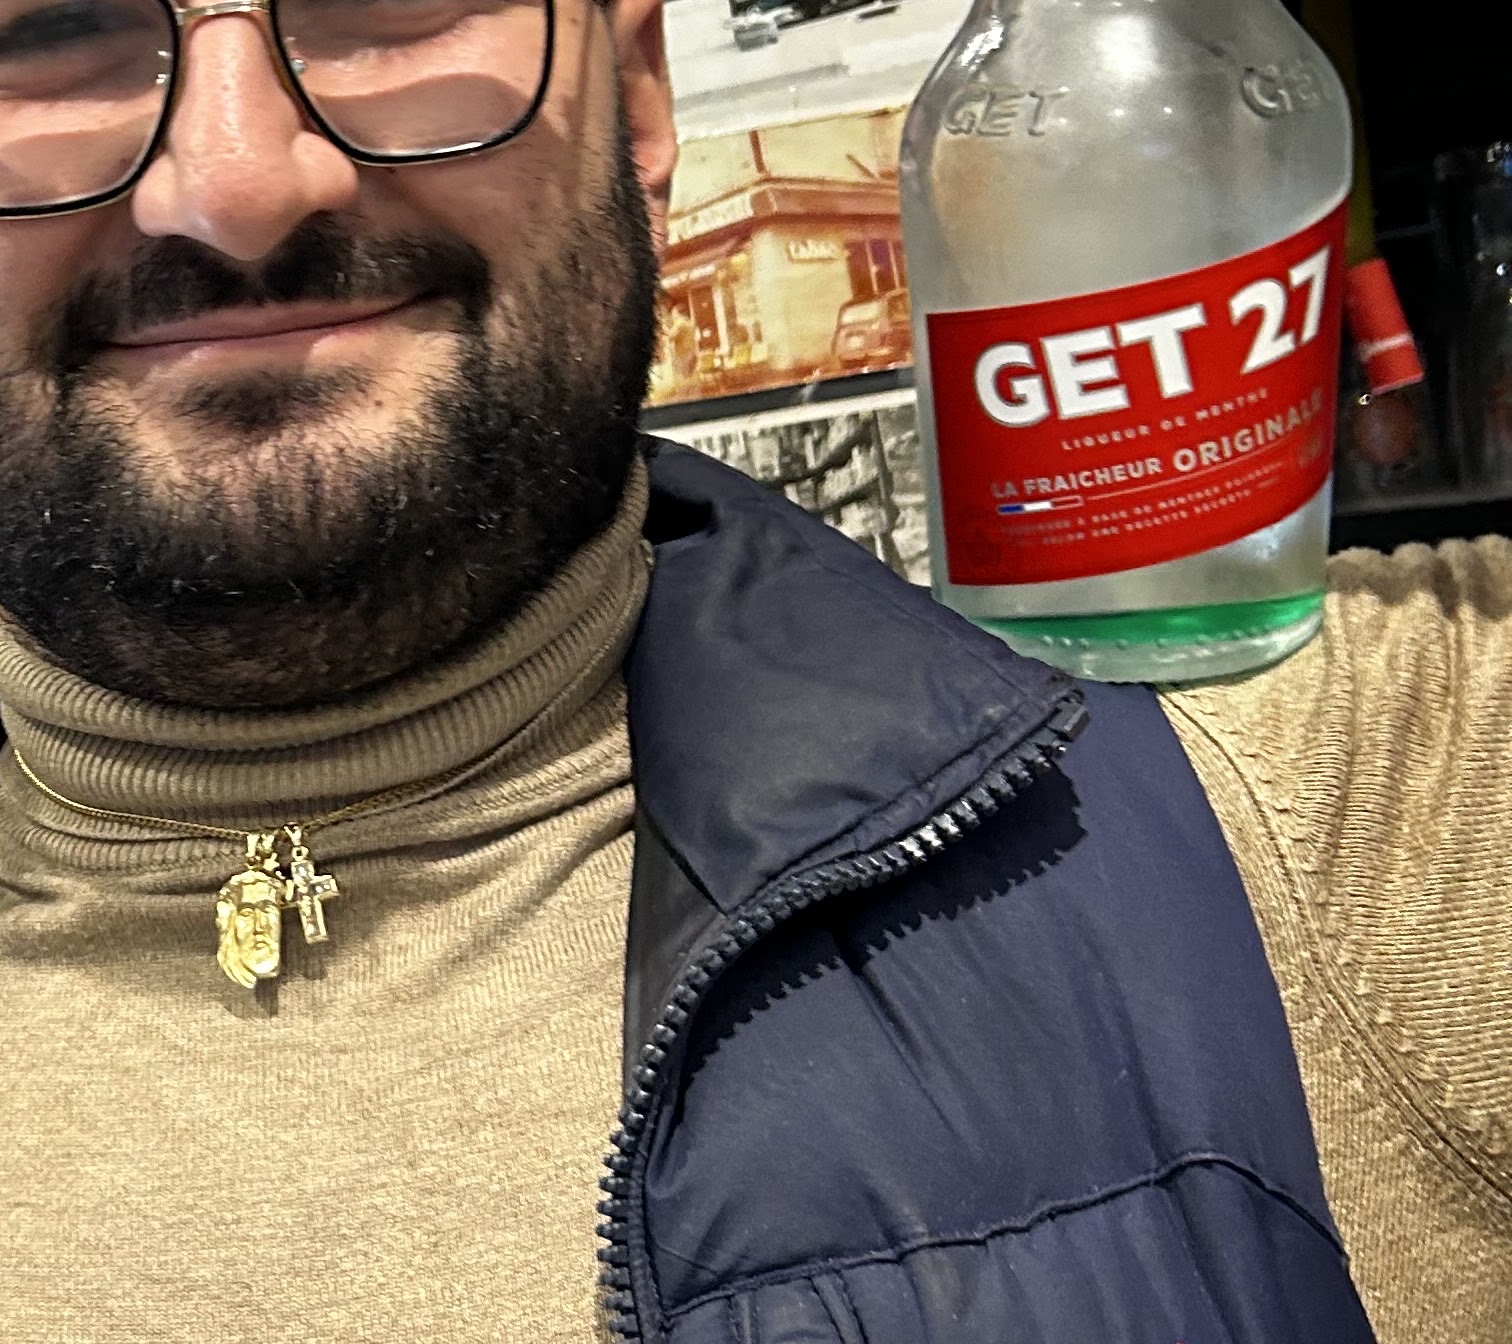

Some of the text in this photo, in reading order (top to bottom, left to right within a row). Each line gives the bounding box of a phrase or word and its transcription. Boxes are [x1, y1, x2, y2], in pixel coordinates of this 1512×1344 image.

[942, 83, 1071, 137] GET
[974, 244, 1332, 429] GET 27
[991, 386, 1324, 500] LA FRAICHEUR ORIGINALE
[1060, 386, 1269, 451] LIQUEUR DE MENTHE
